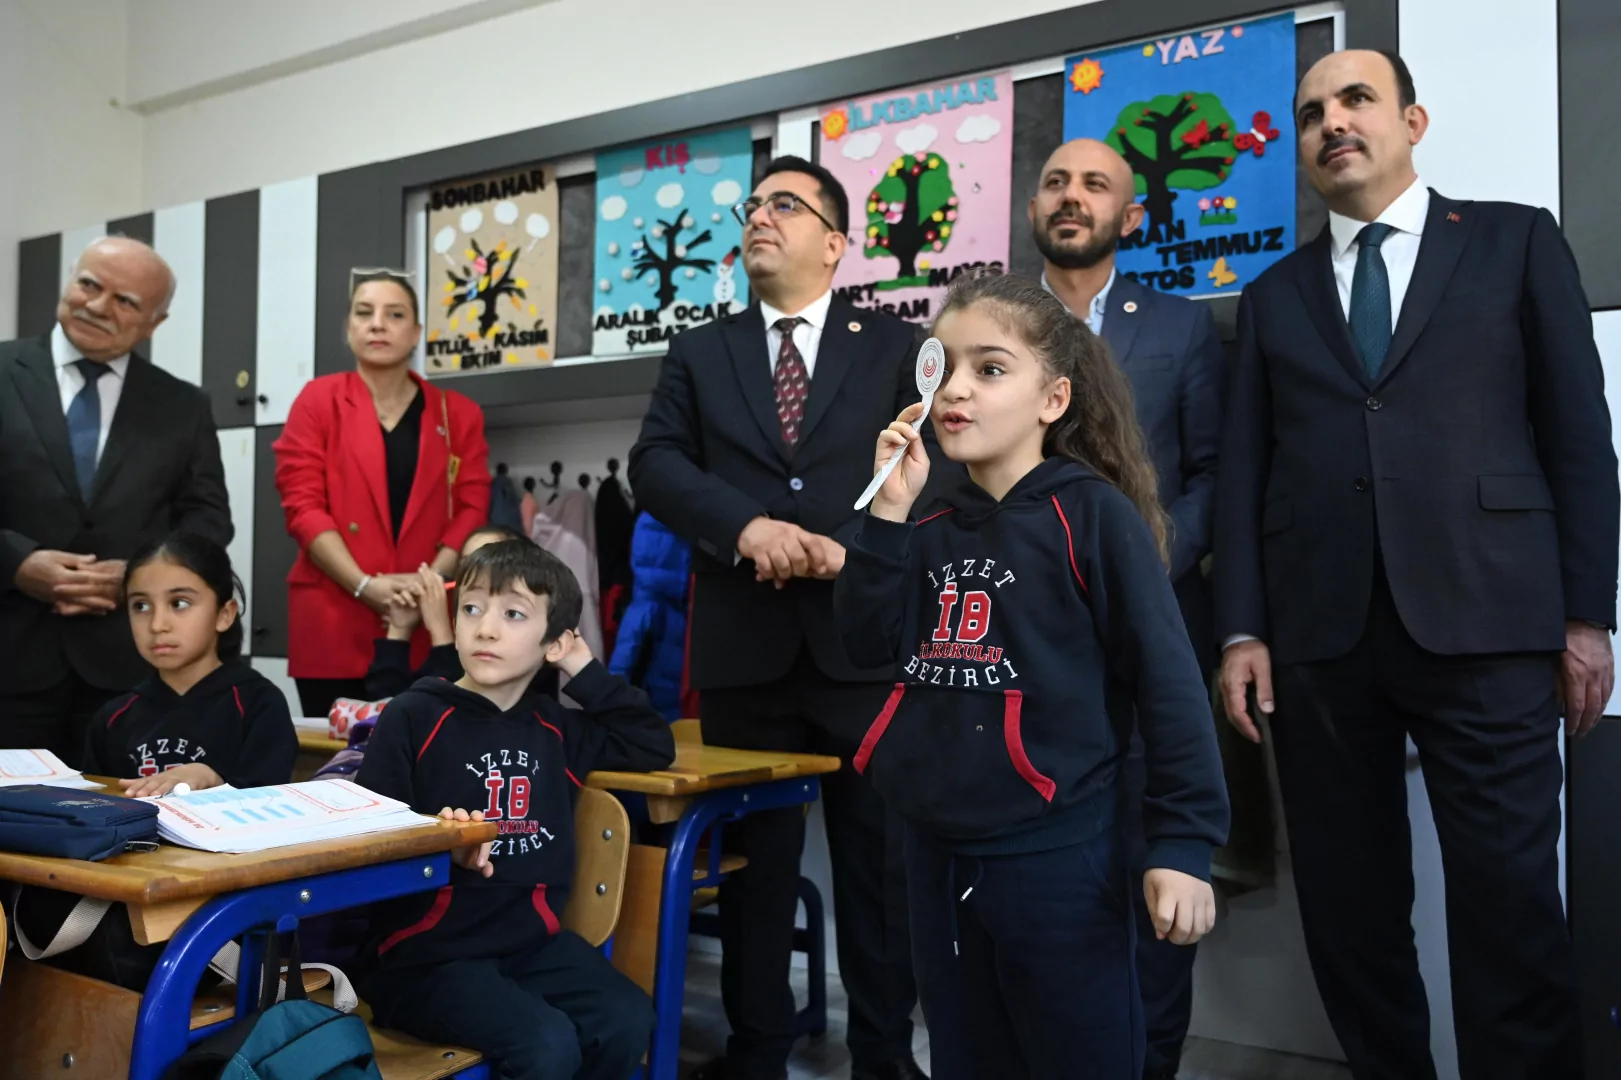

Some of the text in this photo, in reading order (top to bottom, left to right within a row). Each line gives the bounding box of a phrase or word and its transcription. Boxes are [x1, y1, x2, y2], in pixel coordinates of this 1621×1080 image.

[1156, 29, 1225, 65] YAZ
[848, 77, 998, 131] İLKBAHAR
[646, 142, 690, 174] KIŞ
[431, 170, 545, 211] SONBAHAR
[1156, 227, 1284, 267] TEMMUZ
[595, 302, 731, 331] ARALIK OCAK
[427, 329, 548, 357] EYLÜL KASIM
[928, 559, 1016, 588] İZZET
[932, 581, 991, 643] İB
[919, 641, 1003, 664] İLKOKULU
[904, 655, 1018, 687] BEZİRCİ
[484, 769, 531, 820] İB
[490, 826, 554, 855] ZİRCİ
